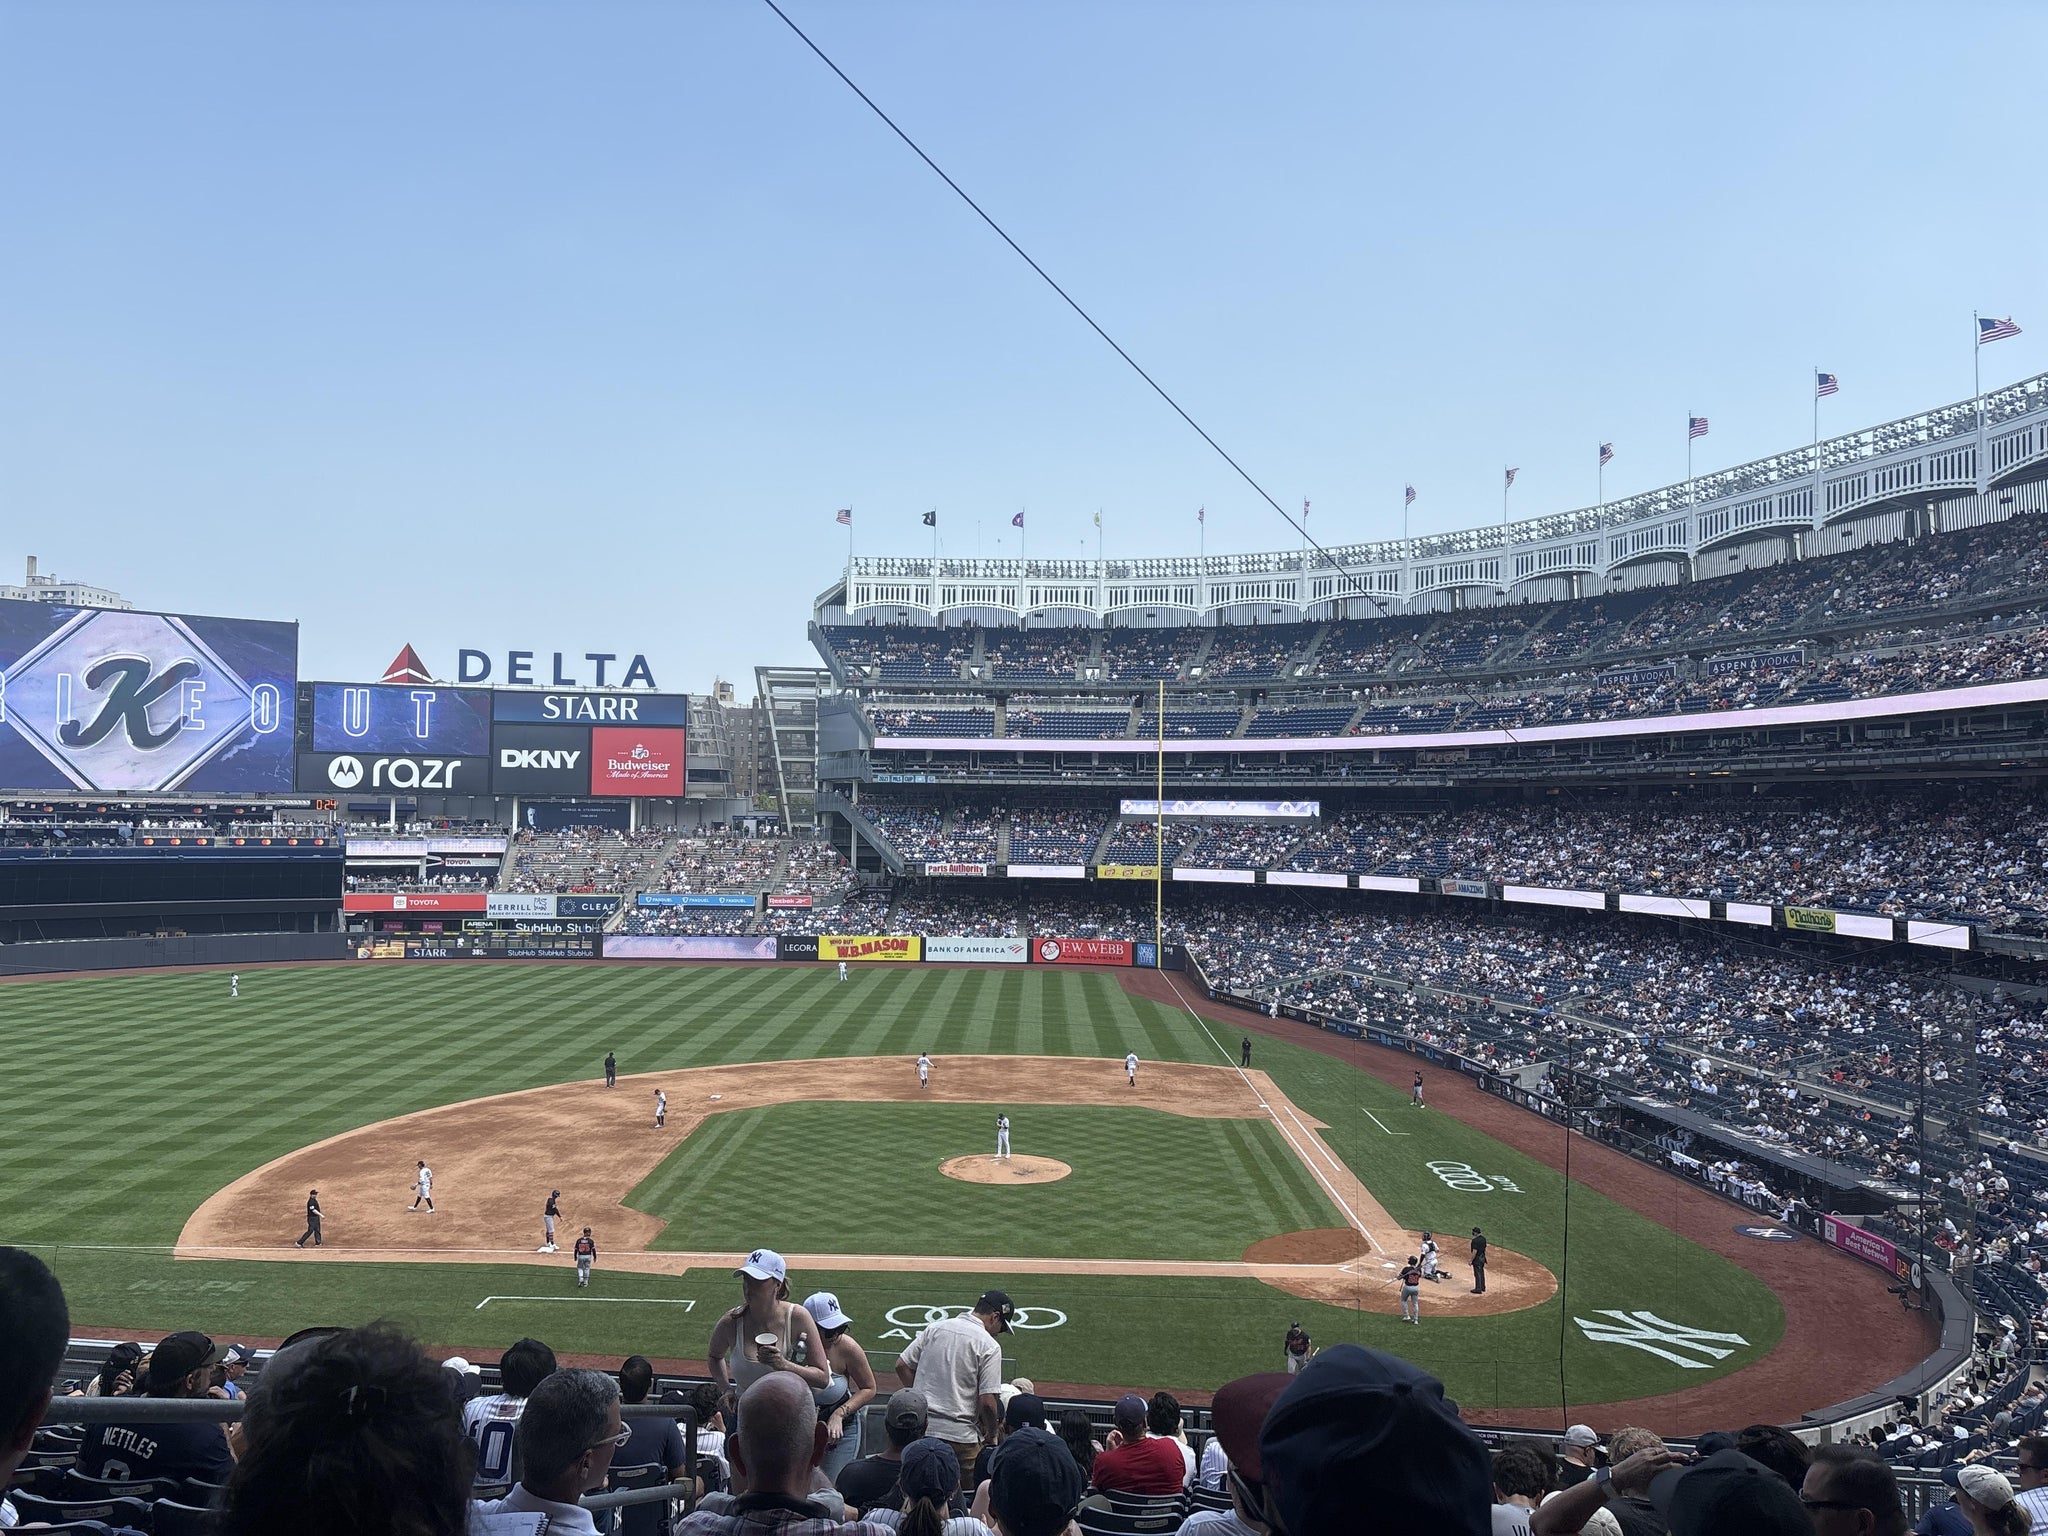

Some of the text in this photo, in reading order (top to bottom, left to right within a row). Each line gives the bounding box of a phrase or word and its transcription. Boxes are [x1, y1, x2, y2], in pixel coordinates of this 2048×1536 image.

[458, 649, 656, 687] DELTA
[1712, 654, 1797, 673] ASPEN VODKA
[1602, 670, 1671, 685] ASPEN VODKA
[542, 695, 639, 721] STARR
[500, 749, 580, 769] DKNY
[608, 759, 670, 771] Budweiser
[372, 757, 461, 788] razr
[630, 771, 638, 779] of
[316, 800, 337, 810] 0:24
[928, 864, 984, 872] Parts Authority
[516, 923, 562, 933] StubHub
[414, 949, 447, 957] STARR
[785, 944, 817, 952] LEGORA
[1062, 942, 1084, 953] F.W.
[1087, 943, 1124, 955] WEBB
[1850, 1231, 1885, 1253] America's
[1845, 1237, 1889, 1264] Best Network
[102, 1426, 158, 1459] NETTLES
